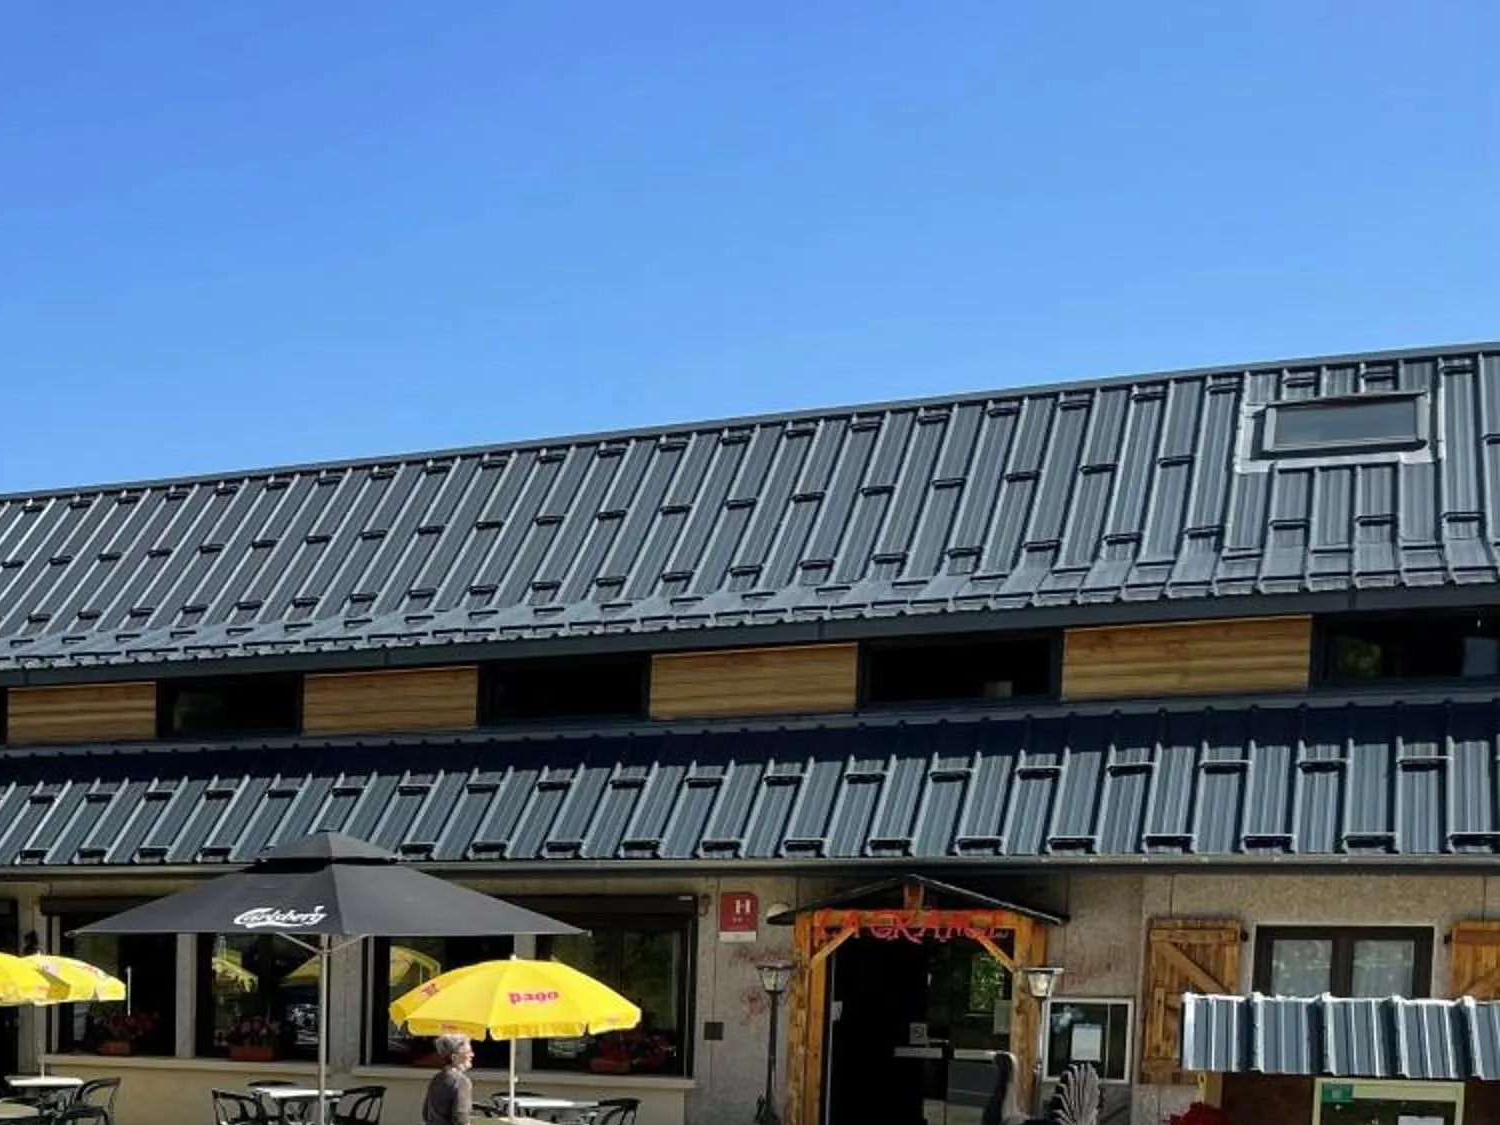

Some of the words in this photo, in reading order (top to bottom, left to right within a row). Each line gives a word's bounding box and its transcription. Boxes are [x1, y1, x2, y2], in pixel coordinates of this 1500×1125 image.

[735, 899, 751, 915] H
[233, 905, 328, 928] Carlsberg
[507, 989, 560, 1006] pago
